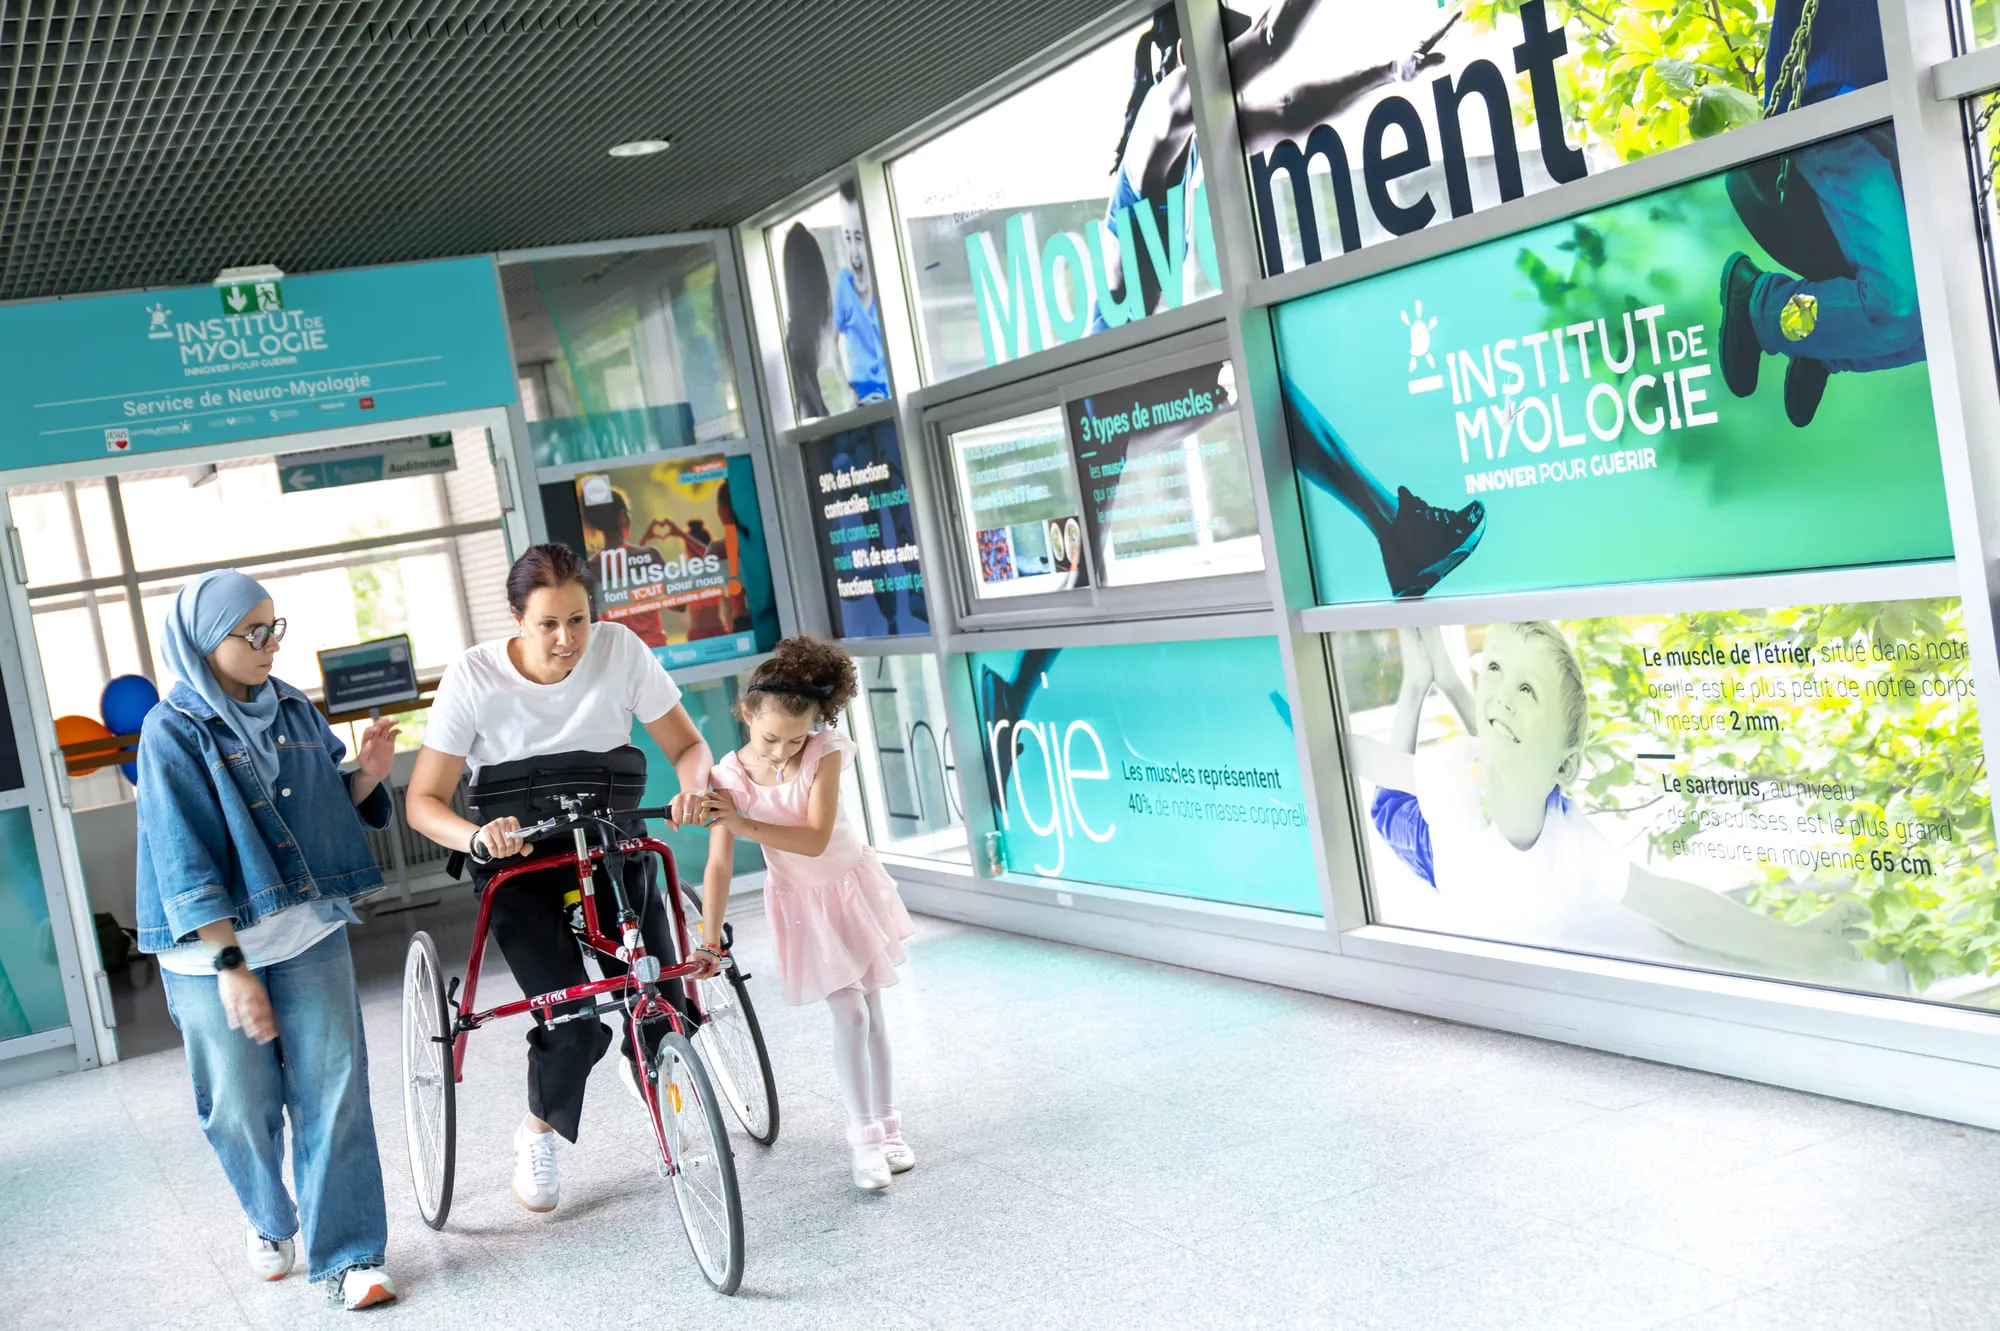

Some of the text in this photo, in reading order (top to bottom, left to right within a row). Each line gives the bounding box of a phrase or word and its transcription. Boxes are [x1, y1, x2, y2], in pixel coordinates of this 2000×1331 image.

[1251, 0, 1588, 278] ment
[176, 310, 323, 343] INSTITUT DE
[180, 330, 328, 365] MYOLOGIE
[1446, 304, 1707, 405] INSTITUT DE
[184, 364, 230, 376] INNOVER
[231, 360, 260, 371] POUR
[123, 396, 194, 417] Service
[200, 391, 222, 408] de
[227, 373, 371, 405] Neuro-Myologie
[1080, 416, 1091, 442] 3
[1092, 412, 1130, 445] types
[1132, 401, 1150, 430] de
[1152, 388, 1213, 425] muscles
[1454, 364, 1718, 464] MYOLOGIE
[389, 456, 451, 474] Auditorium
[836, 470, 852, 490] des
[850, 461, 890, 486] fonctions
[1464, 447, 1657, 494] INNOVER POUR GUÉRIR
[628, 554, 652, 566] nos
[870, 546, 881, 566] de
[881, 548, 897, 564] ses
[604, 588, 629, 602] font
[631, 584, 663, 600] TOUT
[666, 580, 693, 594] pour
[696, 576, 724, 588] nous
[837, 575, 875, 597] fonctions
[1643, 637, 1969, 667] Le muscle de l'étrier, situé dans notr
[1702, 679, 1728, 698] est
[1731, 676, 1745, 698] le
[1751, 676, 1786, 702] plus
[1792, 676, 1832, 703] petit
[1837, 674, 1859, 698] de
[1866, 677, 1916, 697] notre
[1666, 713, 1726, 731] mesure
[1729, 711, 1741, 731] 2
[1745, 714, 1785, 732] mm.
[987, 672, 1116, 877] rgie
[1122, 760, 1282, 790] Les muscles représentent
[1662, 773, 1855, 801] Le sartorius, au niveau
[1129, 792, 1308, 831] 40% de notre masse corporell
[1668, 805, 1686, 825] de
[1690, 810, 1720, 827] nos
[1797, 814, 1825, 834] est
[1828, 812, 1844, 835] le
[1850, 812, 1889, 840] plus
[1895, 819, 1953, 845] grand
[1672, 837, 1937, 876] et mesure en moyenne 65 cm.
